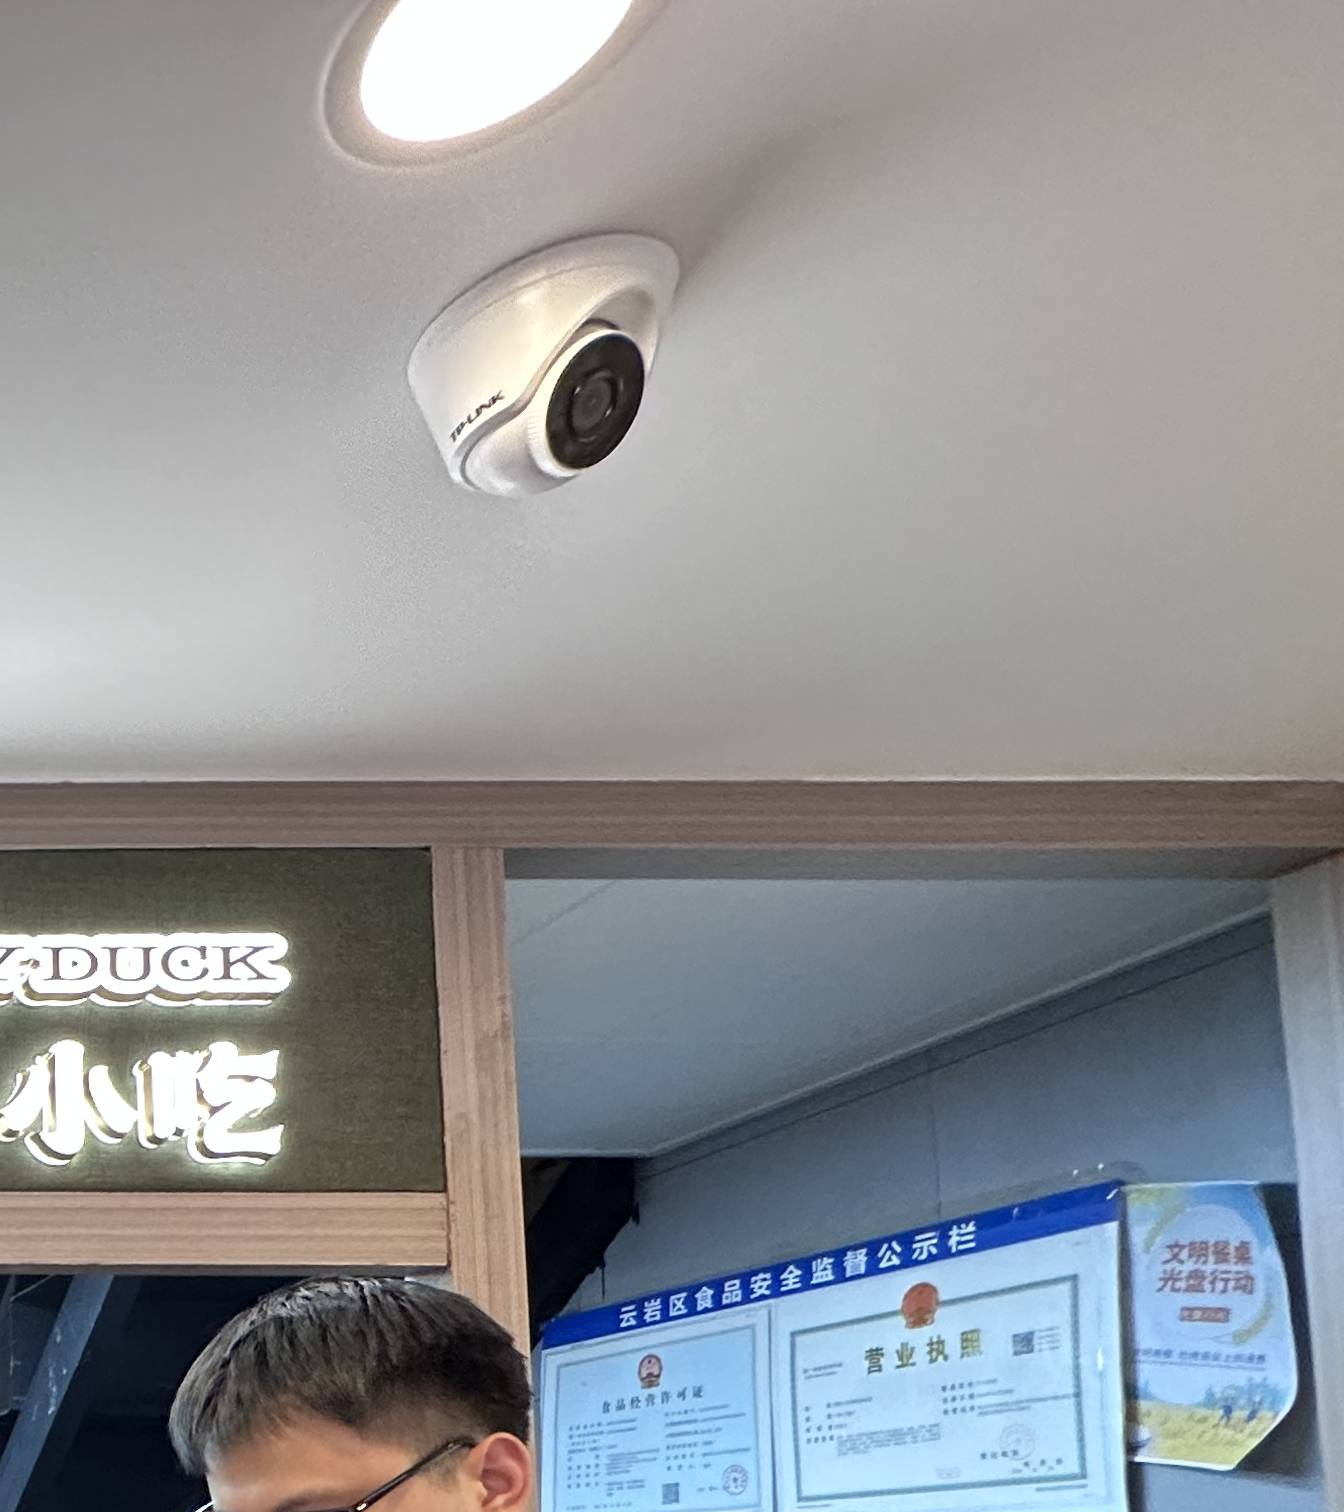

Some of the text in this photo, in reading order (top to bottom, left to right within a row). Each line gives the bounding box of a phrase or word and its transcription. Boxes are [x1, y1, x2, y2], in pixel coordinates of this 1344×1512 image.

[450, 391, 505, 443] TP-LINK
[42, 944, 278, 984] DUCK
[619, 1220, 976, 1328] 云岩区食品安全监督公示栏
[1162, 1240, 1254, 1266] 文明餐桌
[1156, 1269, 1255, 1295] 光盘行动
[864, 1328, 984, 1376] 营业执照
